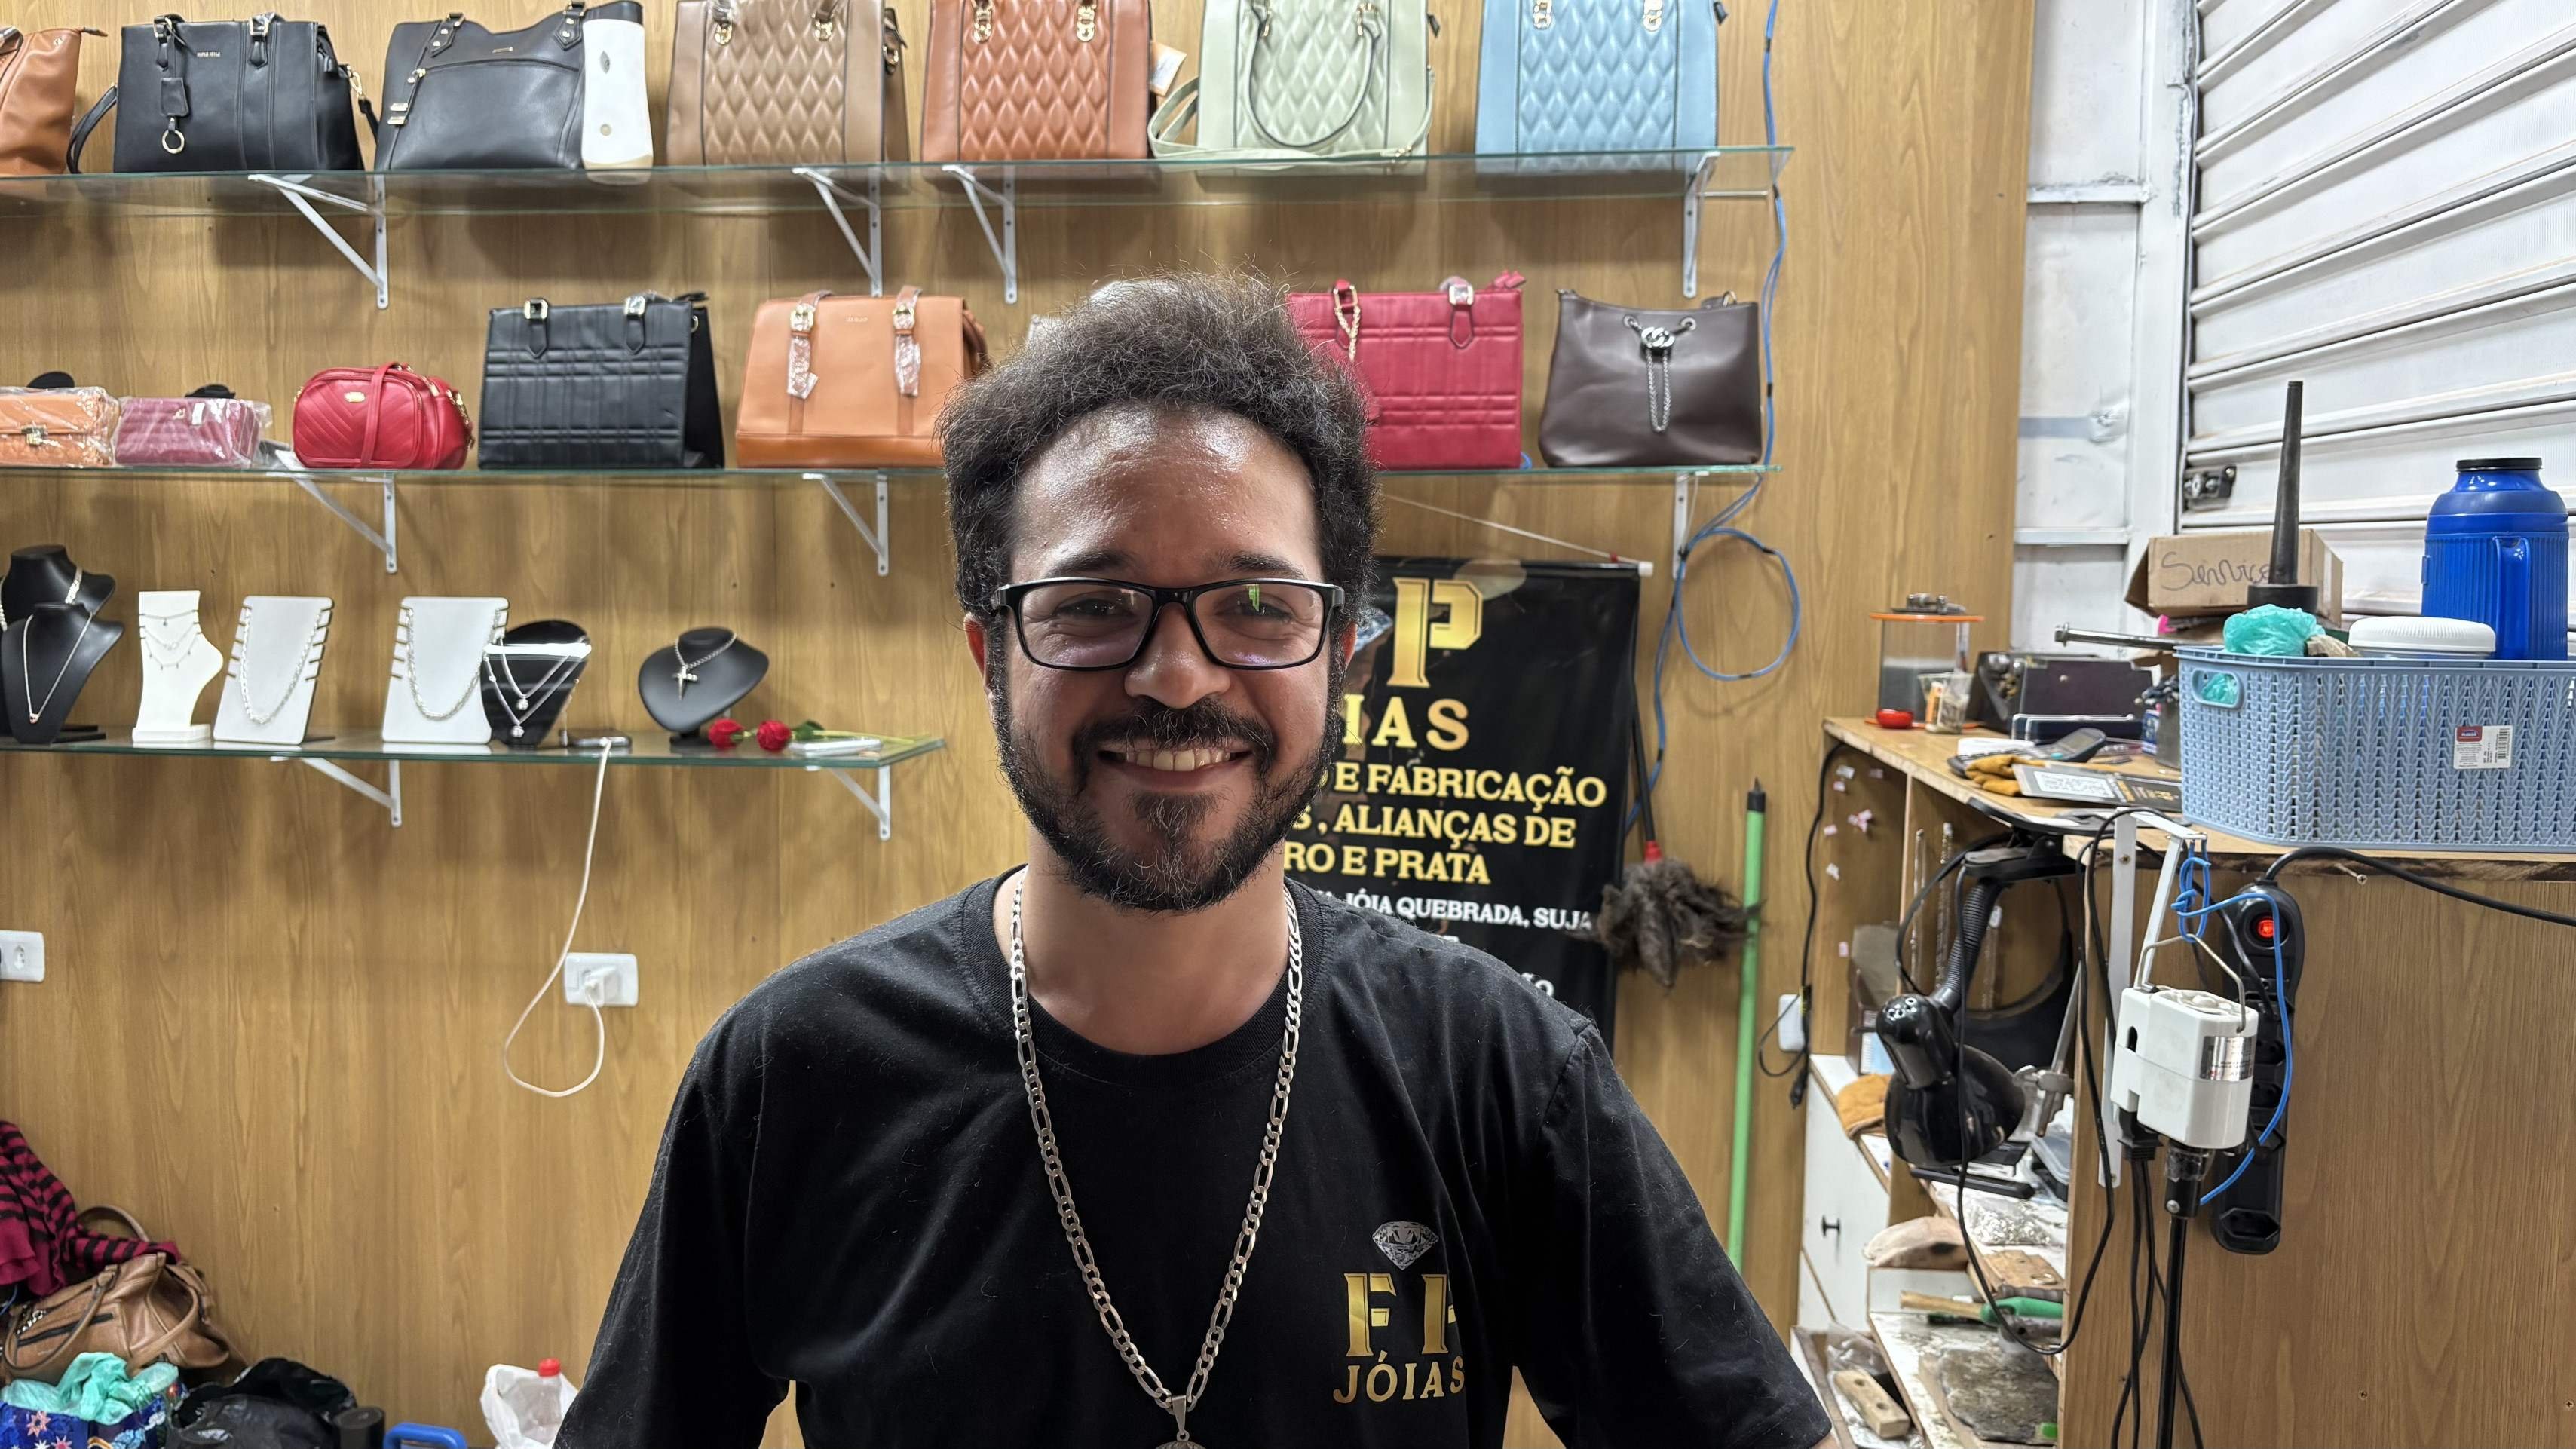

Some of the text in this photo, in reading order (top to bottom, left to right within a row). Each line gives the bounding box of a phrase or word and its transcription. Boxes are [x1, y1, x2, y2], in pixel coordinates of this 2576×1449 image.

[1343, 694, 1469, 751] IAS
[1334, 761, 1360, 792] E
[1366, 763, 1607, 813] FABRICAÇÃO
[1332, 803, 1518, 850] ALIANÇAS
[1523, 815, 1577, 849] DE
[1284, 841, 1491, 885] RO E PRATA
[1395, 896, 1530, 928] QUEBRADA,
[1333, 1349, 1465, 1404] JÓIAS
